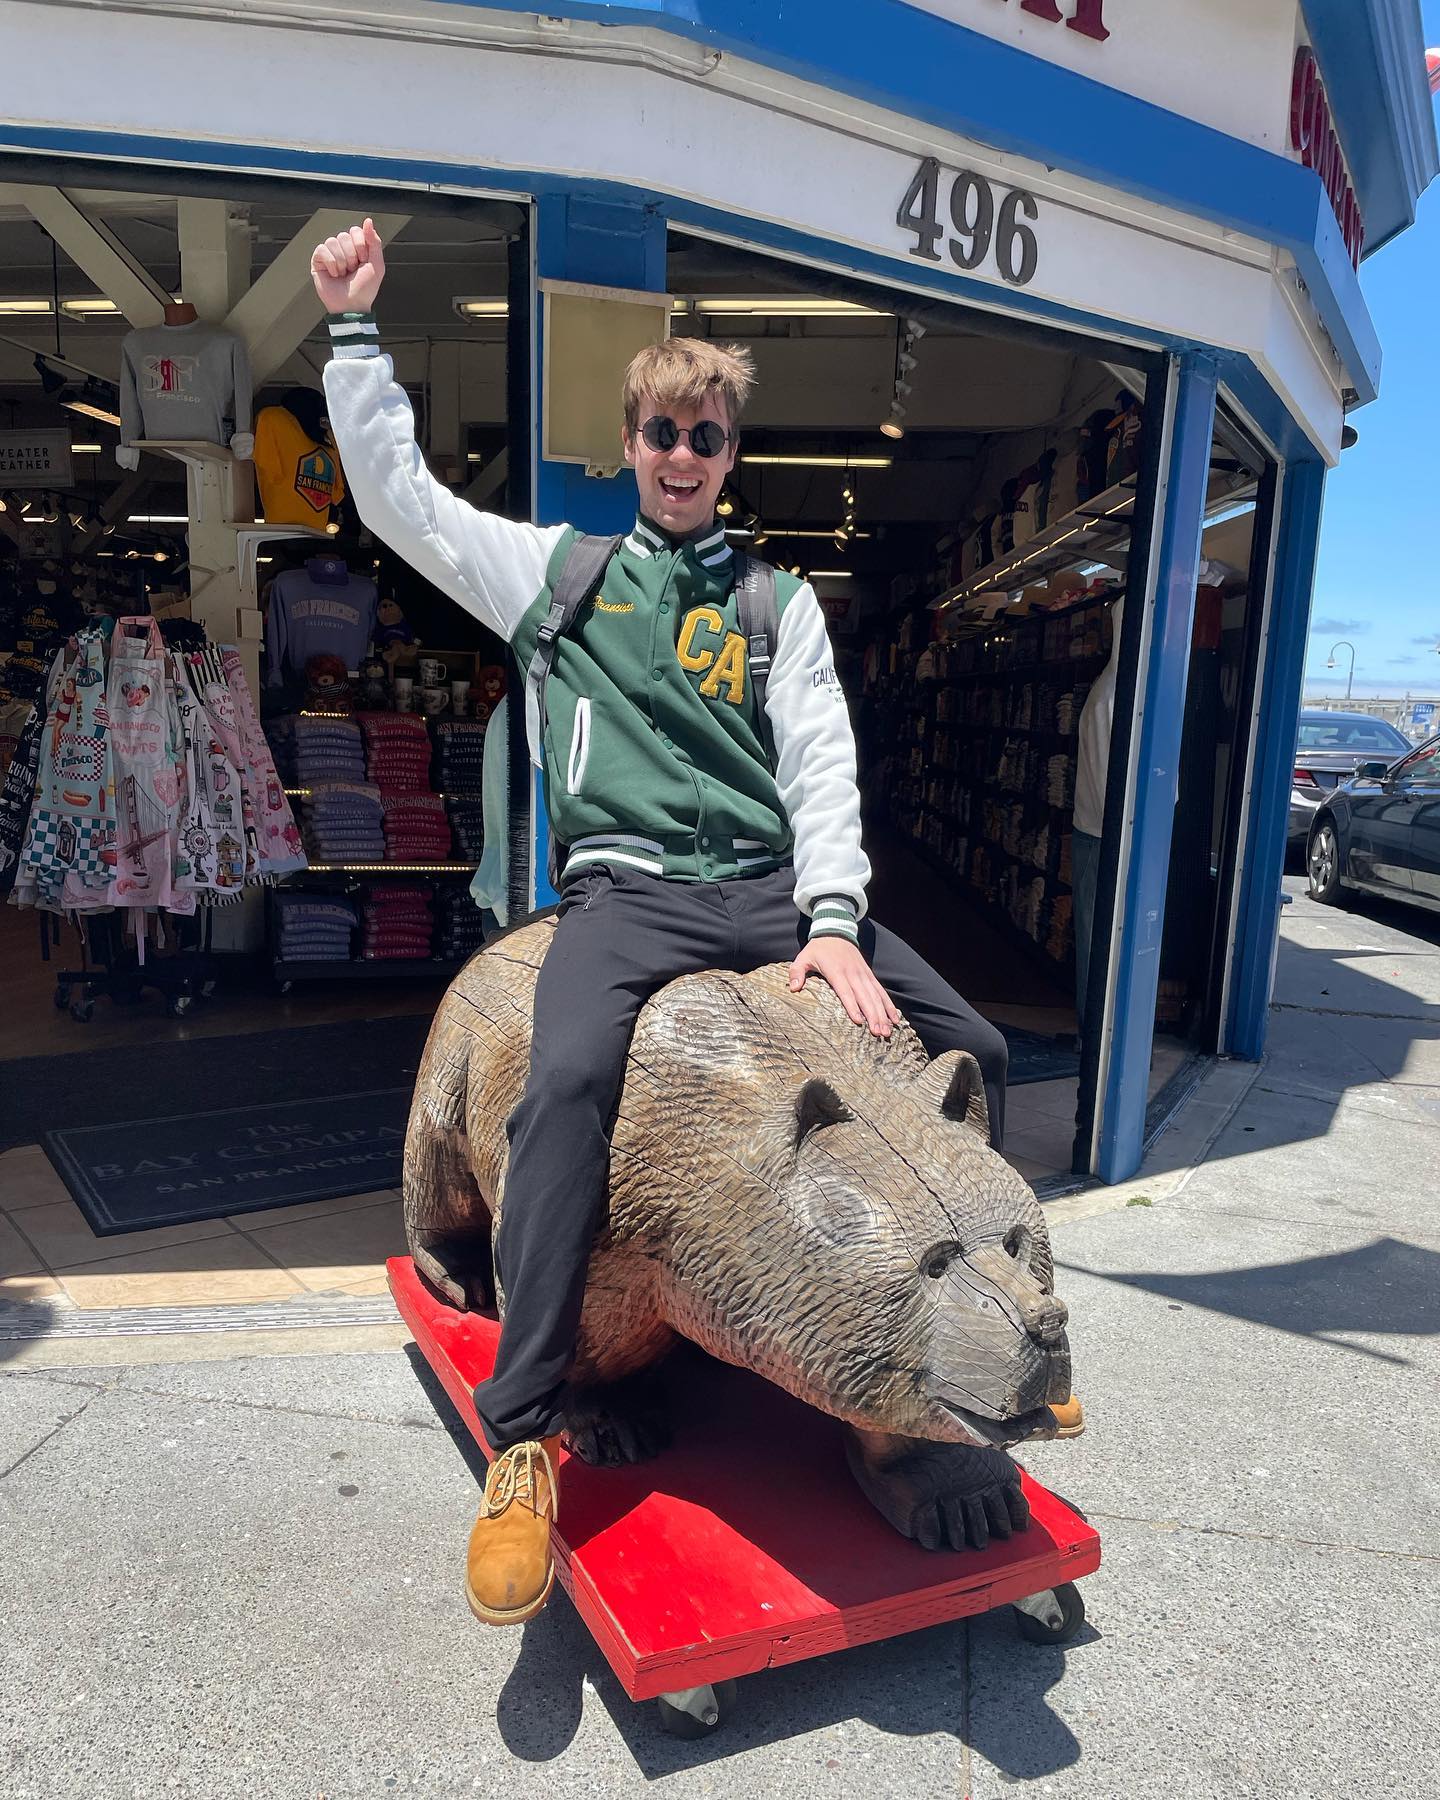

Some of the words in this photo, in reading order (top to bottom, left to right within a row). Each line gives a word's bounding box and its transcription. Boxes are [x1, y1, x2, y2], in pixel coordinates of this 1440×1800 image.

[896, 157, 1040, 286] 496
[0, 459, 50, 470] EATHER
[677, 607, 748, 705] CA
[236, 1121, 313, 1138] The
[91, 1152, 199, 1179] BAY
[155, 1176, 225, 1194] SAN
